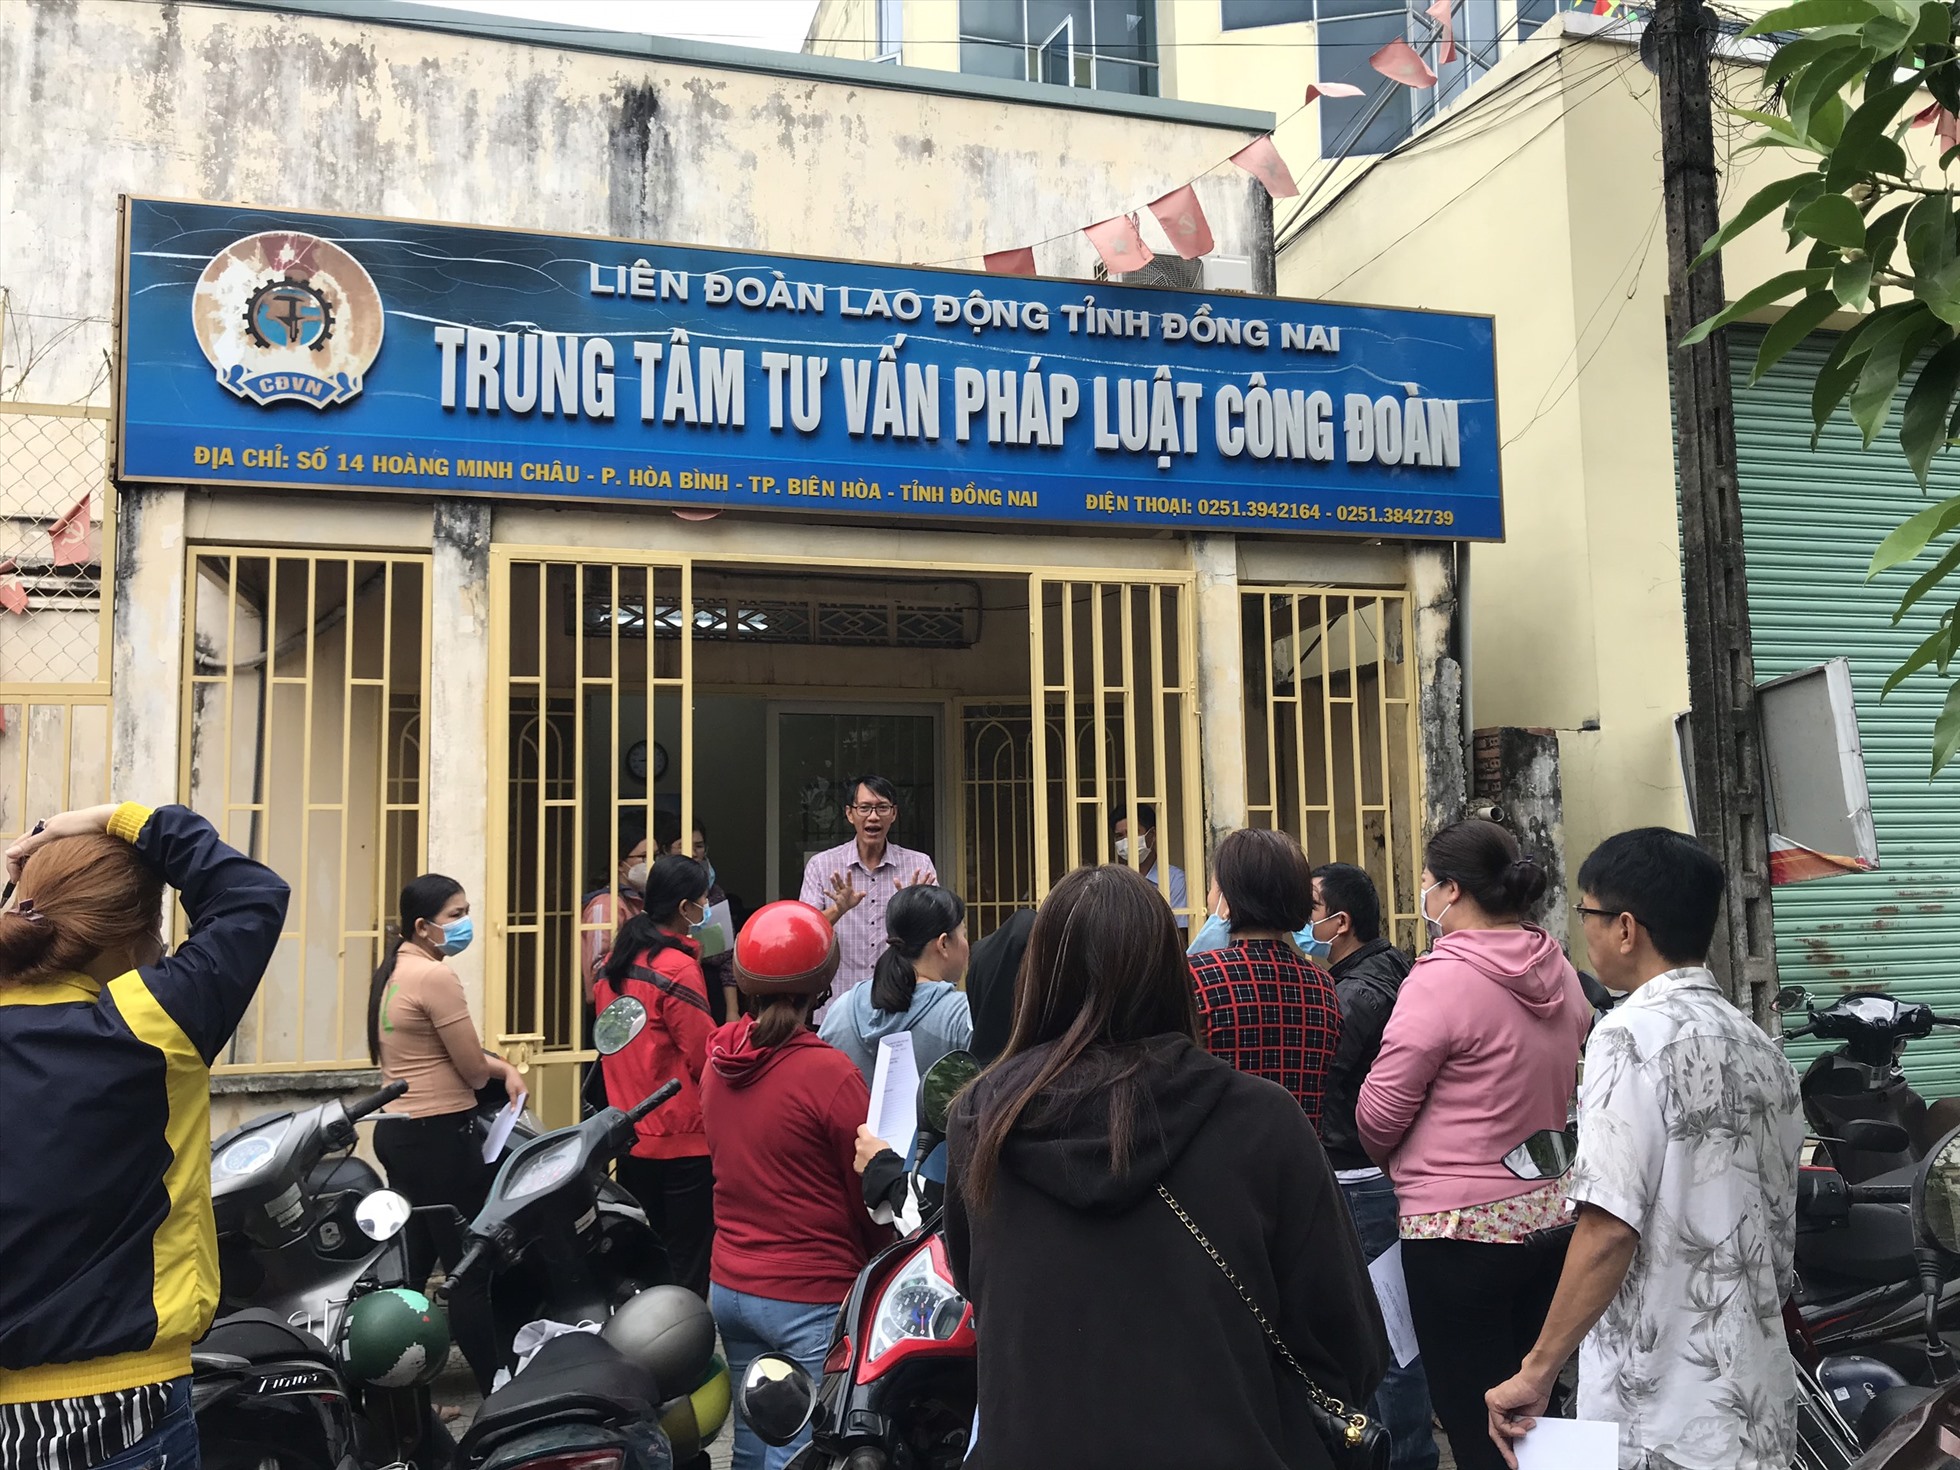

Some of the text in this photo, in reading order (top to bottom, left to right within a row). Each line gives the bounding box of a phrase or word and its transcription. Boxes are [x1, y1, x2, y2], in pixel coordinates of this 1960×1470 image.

[590, 258, 1340, 352] LIÊN ĐOÀN LAO ĐỘNG TỈNH ĐỒNG NAI
[259, 376, 323, 396] CĐVN
[435, 326, 1460, 469] TRUNG TÂM TƯ VẤN PHÁP LUẬT CÔNG ĐOÀN
[194, 446, 234, 470] ĐỊA
[242, 444, 289, 469] CHỈ:
[297, 446, 330, 471] SỐ
[337, 453, 365, 472] 14
[372, 452, 449, 476] HOÀNG
[457, 459, 513, 479] MINH
[520, 460, 580, 483] CHÂU
[601, 467, 621, 485] P.
[629, 466, 672, 488] HÒA
[679, 468, 728, 491] BÌNH
[748, 476, 781, 494] TP.
[788, 475, 835, 497] BIÊN
[841, 477, 882, 500] HÒA
[900, 479, 944, 503] TỈNH
[950, 481, 1001, 506] ĐỒNG
[1007, 490, 1038, 507] NAI
[1085, 490, 1129, 513] ĐIỆN
[1134, 496, 1192, 517] THOẠI:
[1198, 499, 1321, 520] 0251.3942164
[1337, 504, 1454, 526] 0251.3842739
